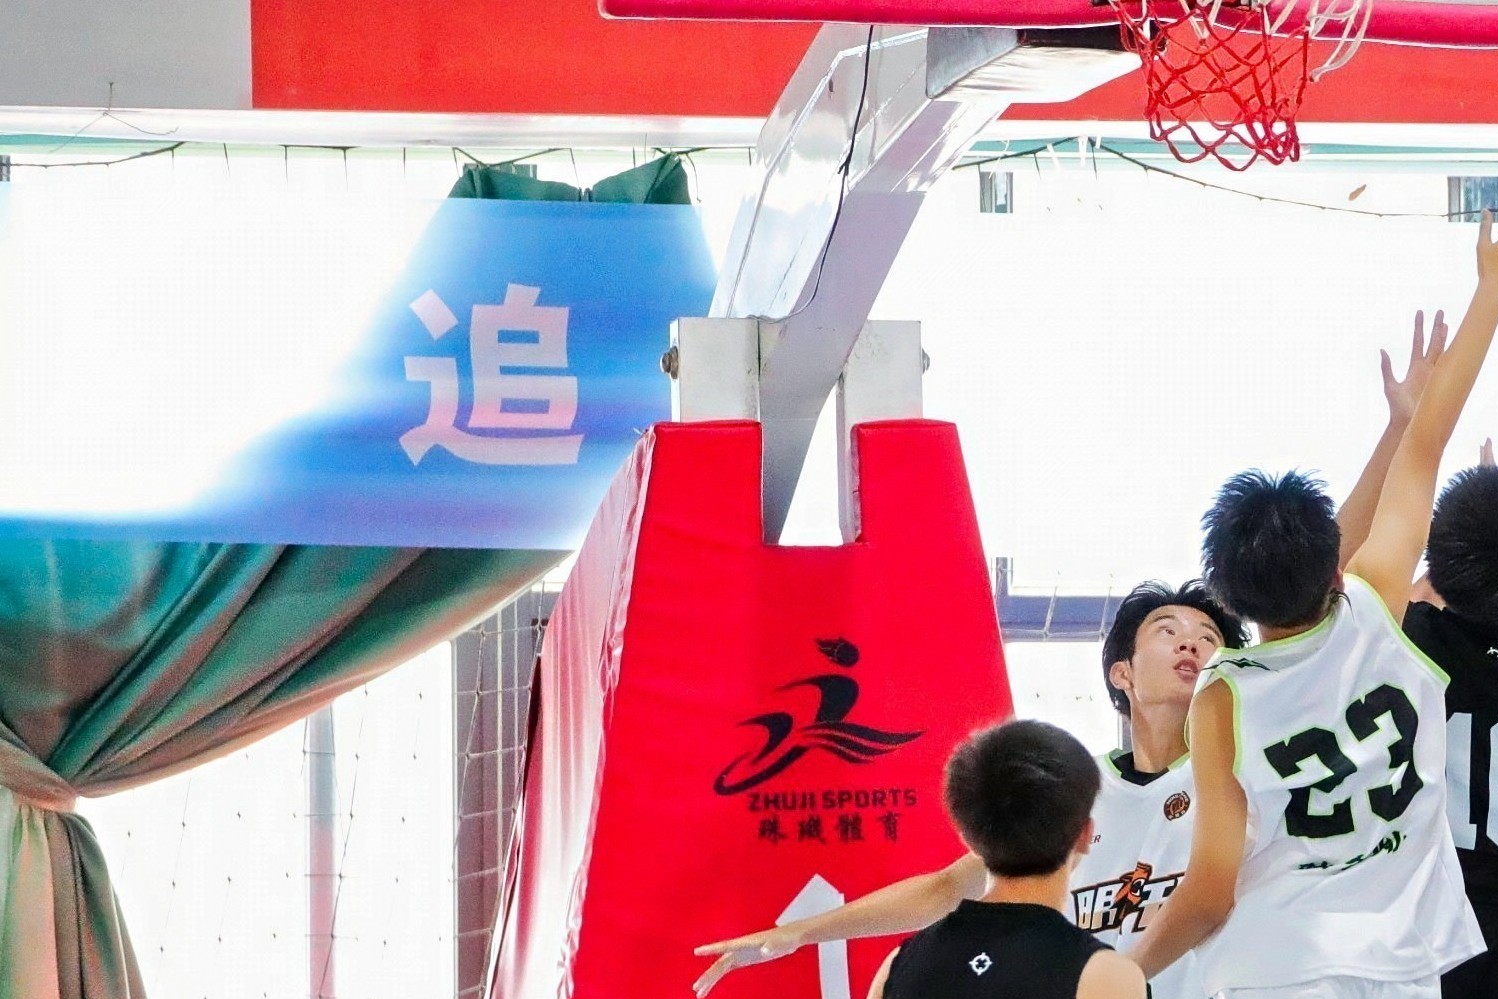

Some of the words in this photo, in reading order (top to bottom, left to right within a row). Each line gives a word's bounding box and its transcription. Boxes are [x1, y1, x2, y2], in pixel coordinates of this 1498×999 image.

[399, 282, 585, 466] 追
[747, 790, 816, 811] ZHUJI
[821, 788, 918, 809] SPORTS
[1263, 683, 1425, 840] 23
